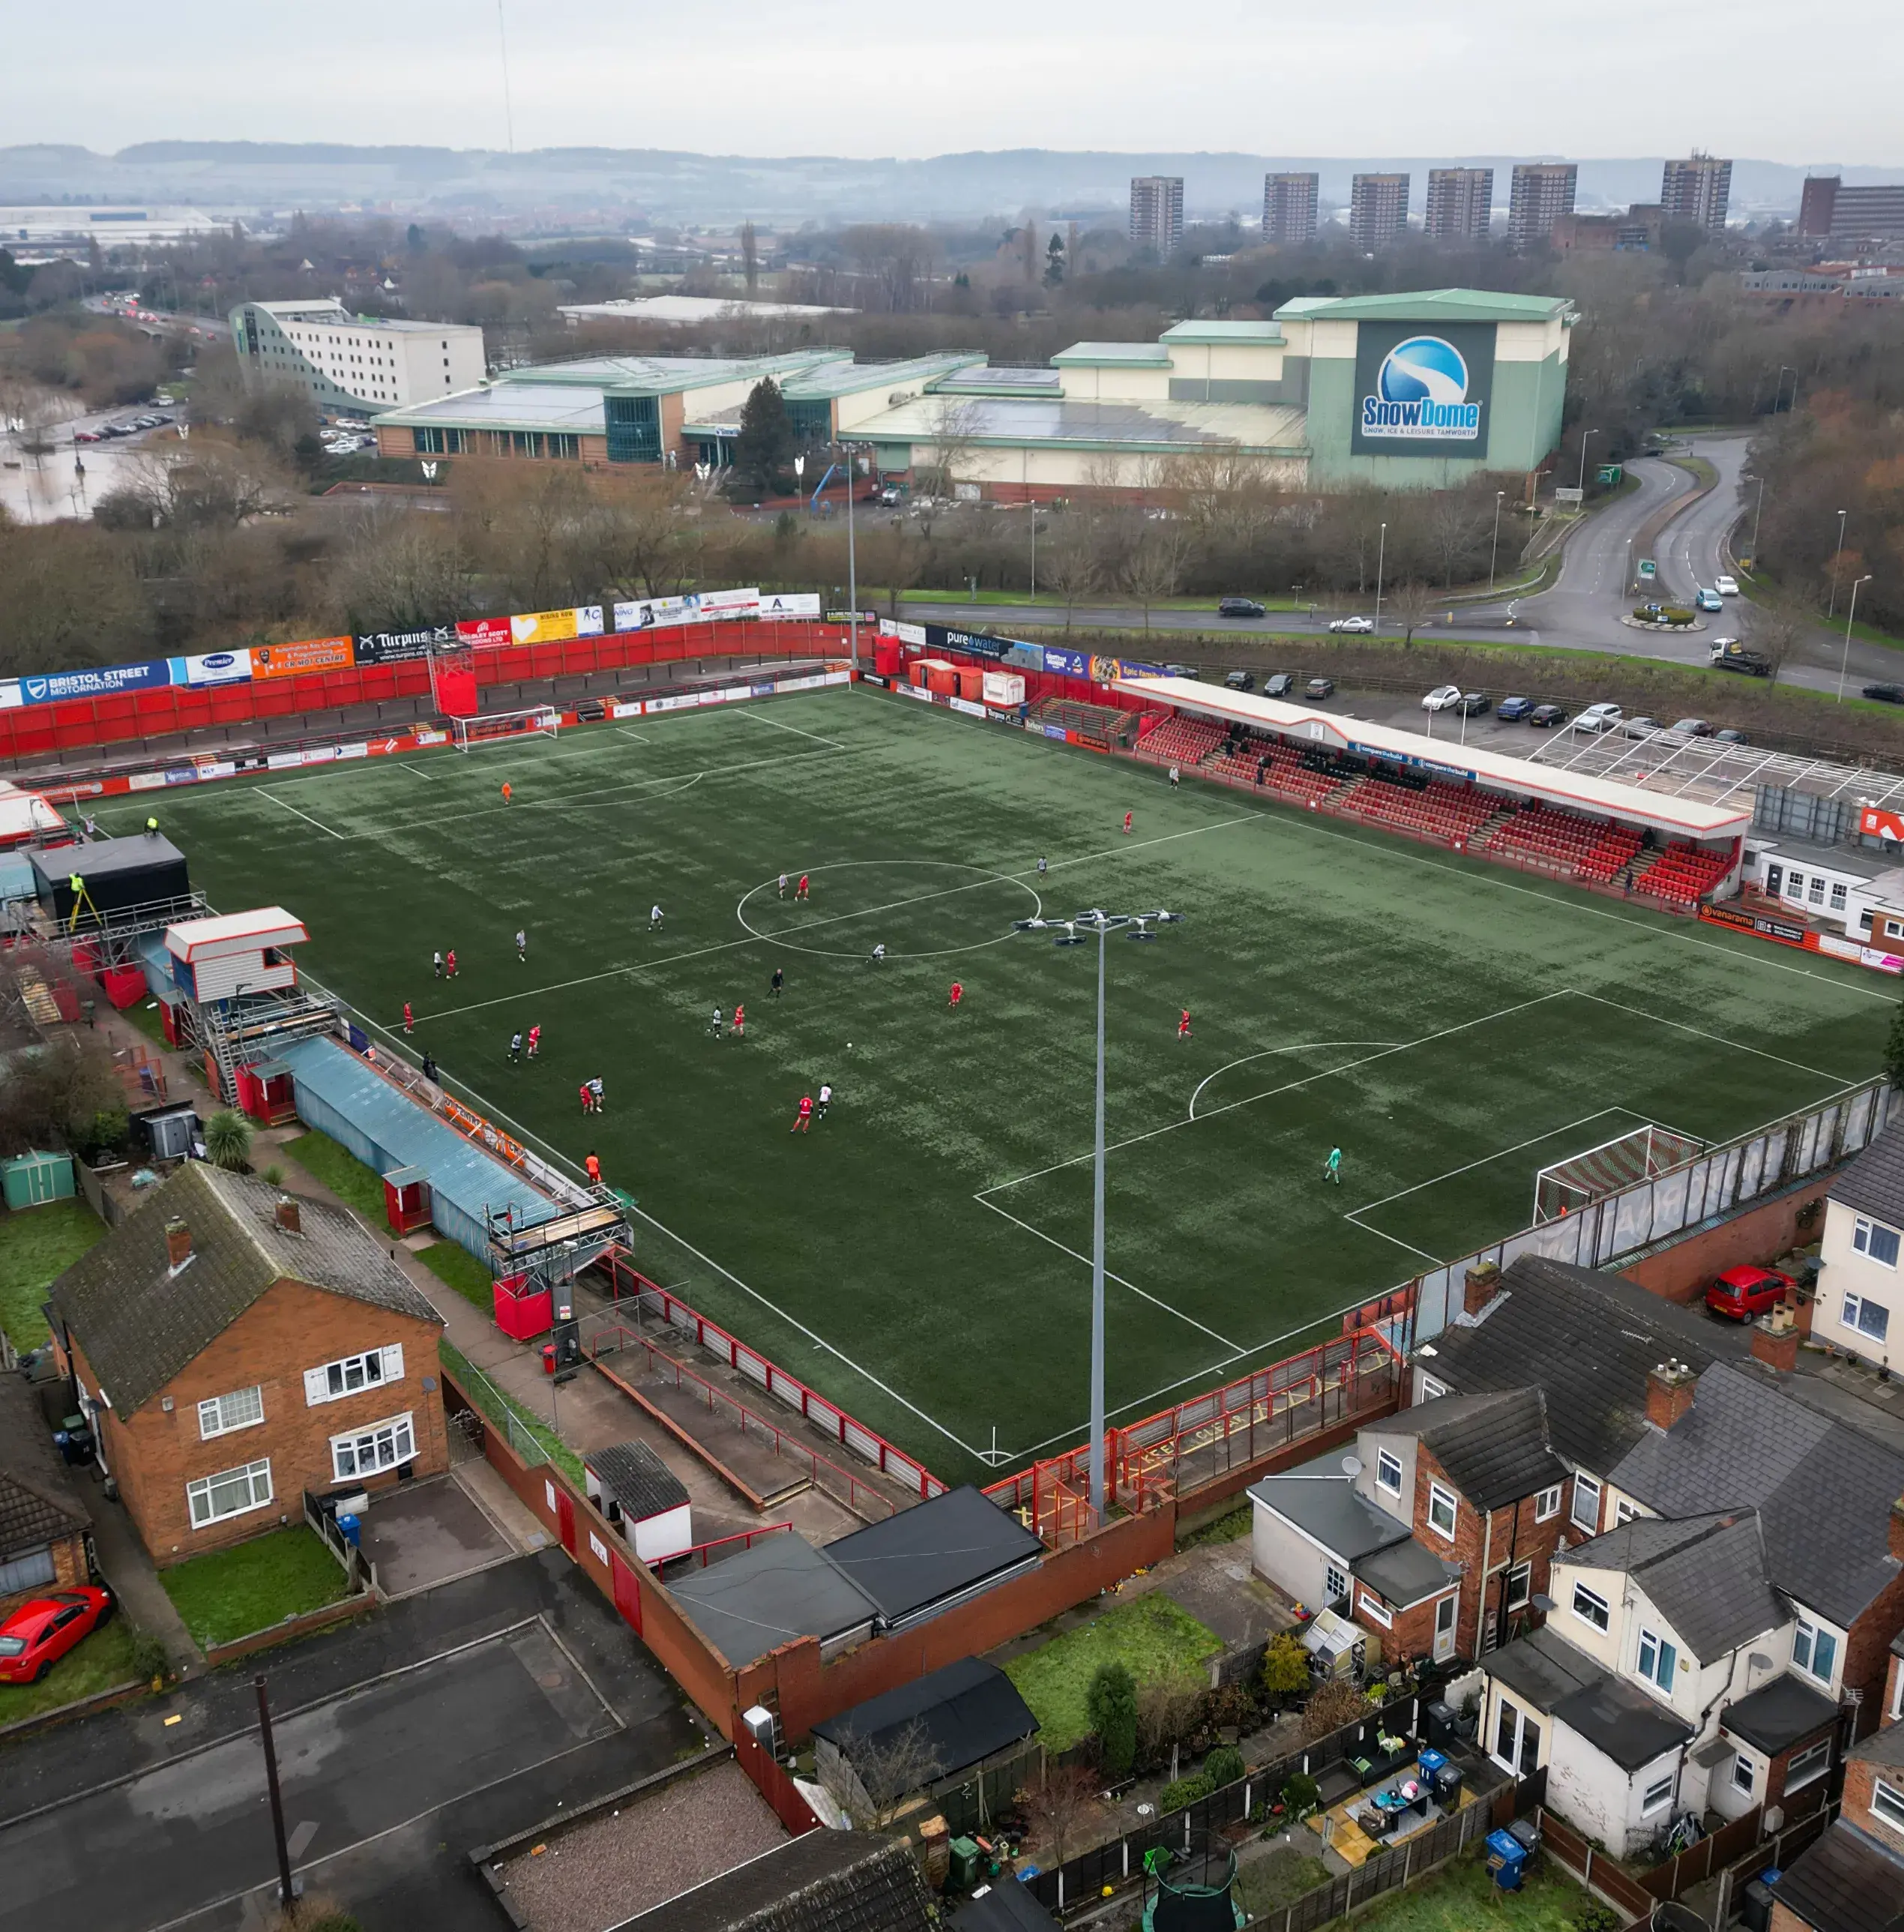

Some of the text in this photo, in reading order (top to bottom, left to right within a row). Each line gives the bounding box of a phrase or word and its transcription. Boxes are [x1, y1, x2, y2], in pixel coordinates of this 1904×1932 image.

[1364, 397, 1479, 428] SnowDome
[376, 631, 428, 647] Turpins
[947, 631, 968, 645] pure
[974, 637, 1001, 651] water
[204, 657, 233, 666] Premier
[315, 654, 346, 663] CENTRE
[49, 666, 149, 688] BRISTOL STREET
[1123, 666, 1138, 678] Epic
[50, 679, 124, 696] MOTORNATION
[1711, 909, 1753, 926] vanarama
